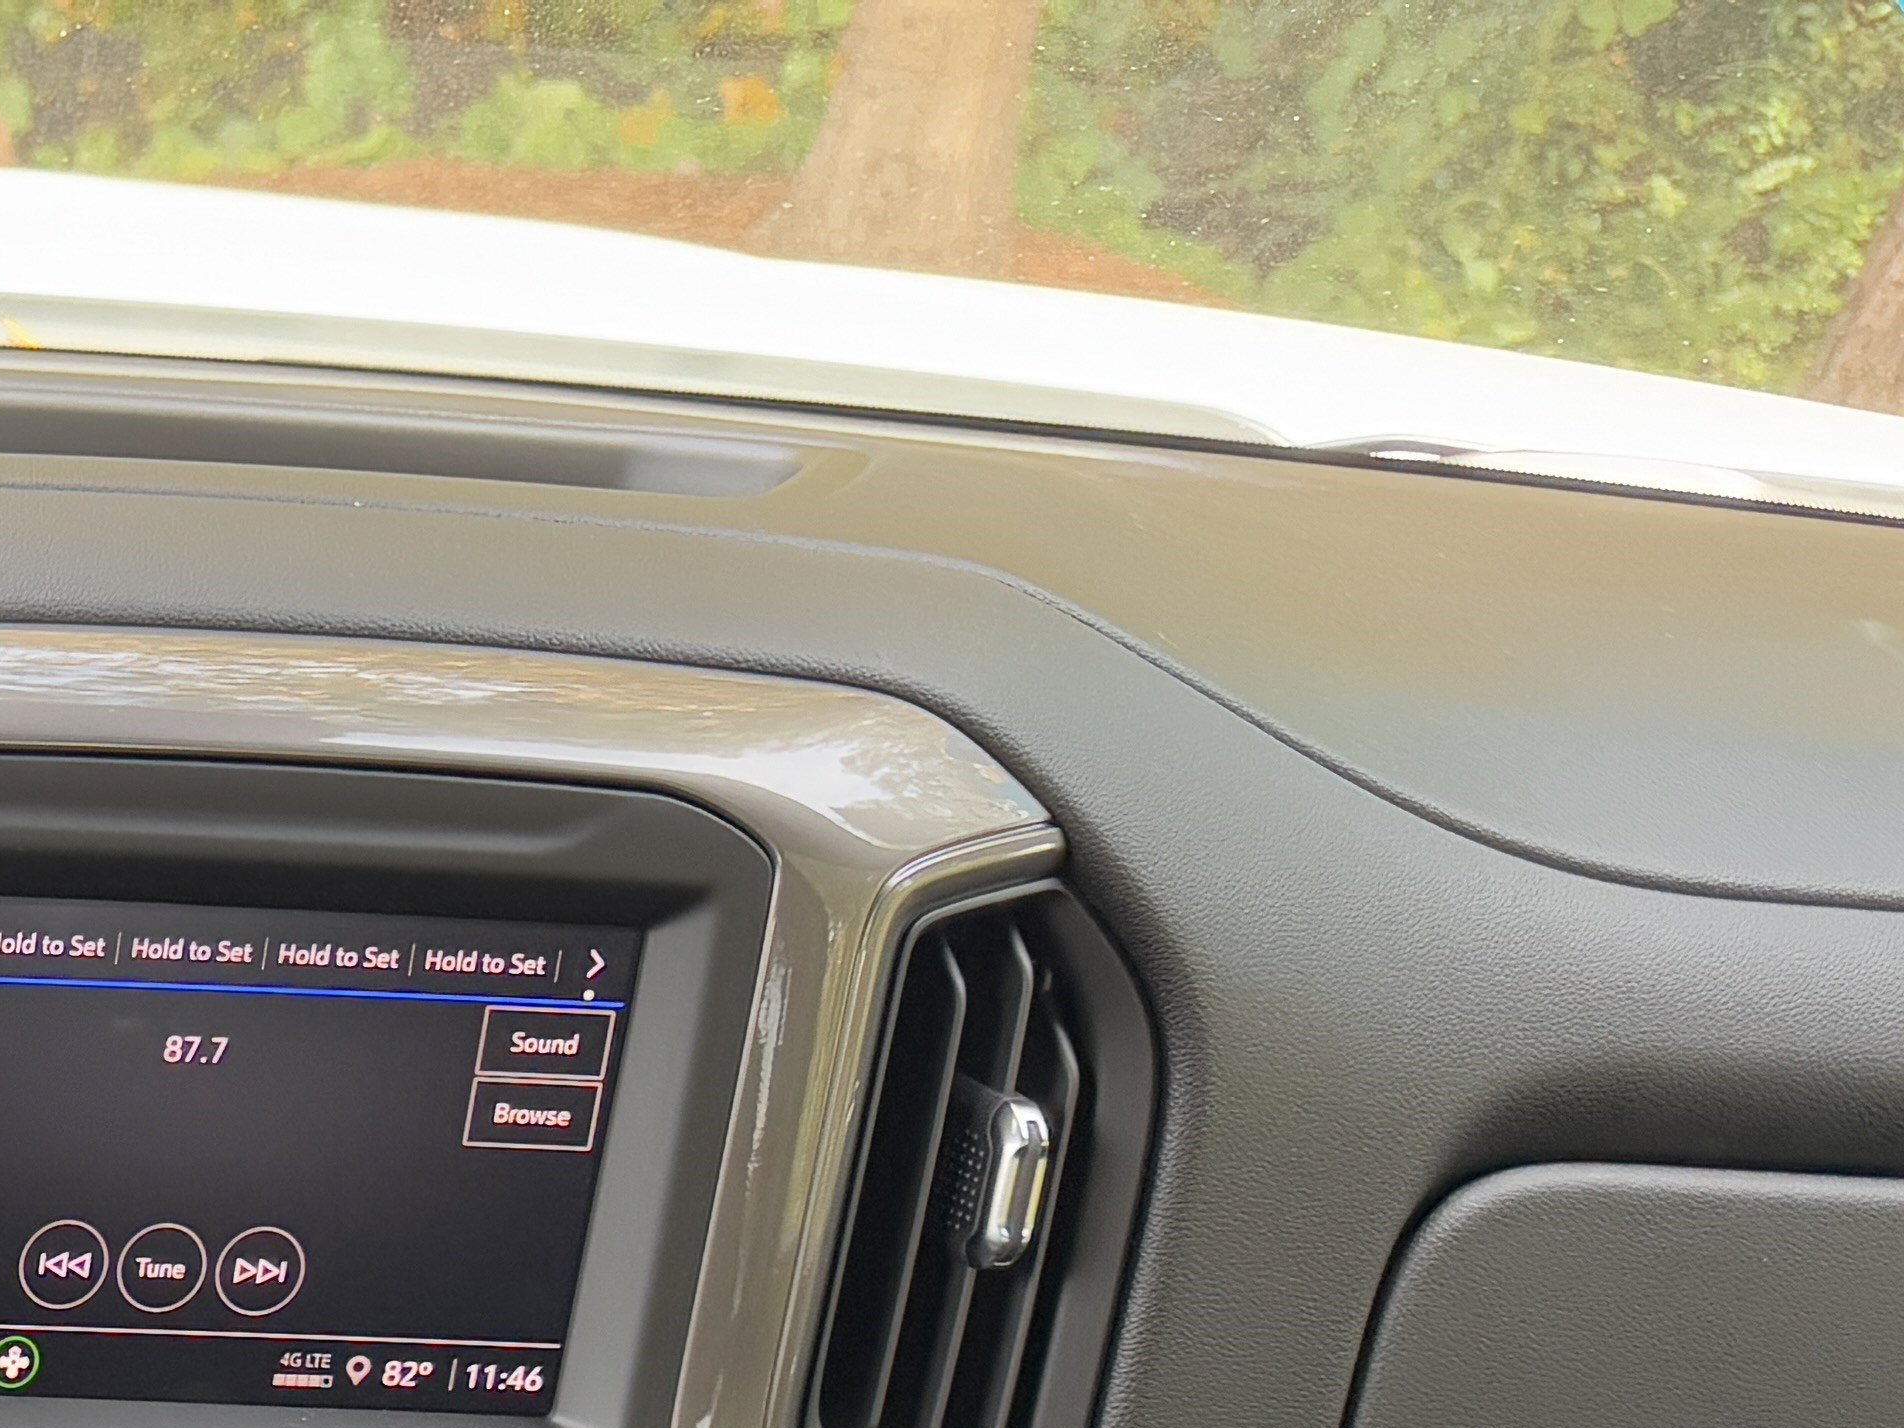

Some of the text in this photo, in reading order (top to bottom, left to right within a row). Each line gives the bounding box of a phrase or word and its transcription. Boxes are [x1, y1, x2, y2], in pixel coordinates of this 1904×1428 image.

[41, 935, 64, 957] to
[69, 935, 106, 959] Set
[130, 938, 253, 964] Hold to Set
[277, 943, 400, 970] Hold to Set
[425, 949, 547, 976] Hold to Set
[162, 1034, 229, 1065] 87.7
[510, 1031, 580, 1057] Sound
[493, 1102, 572, 1128] Browse
[135, 1256, 186, 1280] Tune
[279, 1352, 332, 1369] 4G LTE
[466, 1363, 544, 1392] 11:46
